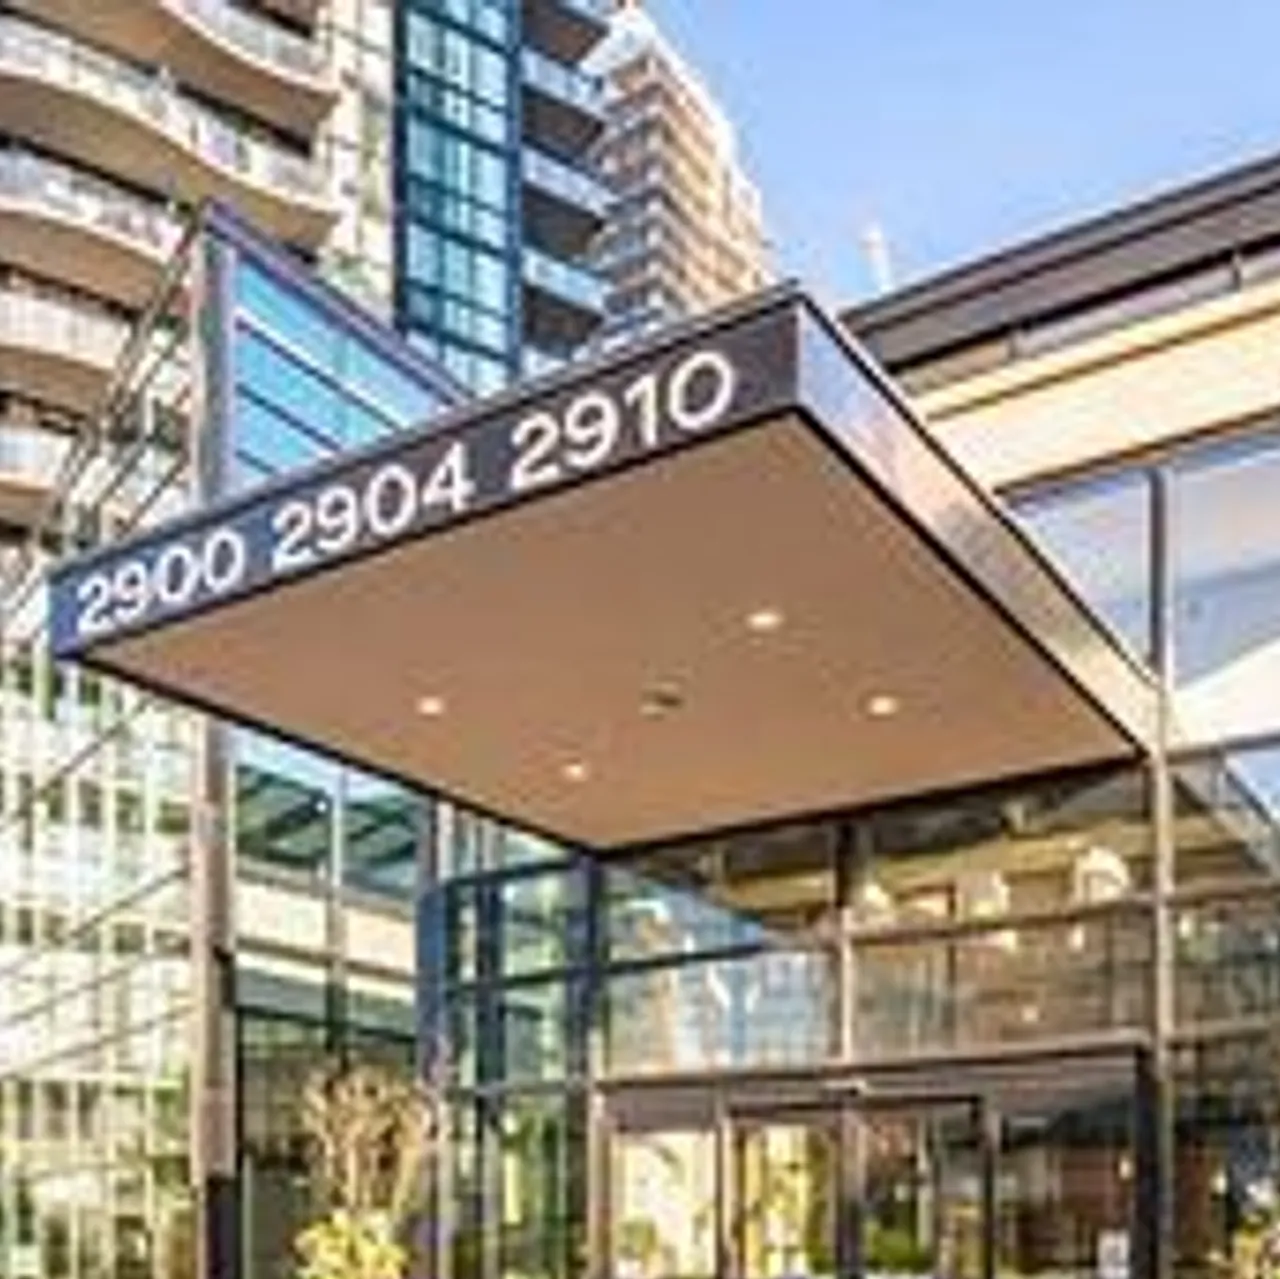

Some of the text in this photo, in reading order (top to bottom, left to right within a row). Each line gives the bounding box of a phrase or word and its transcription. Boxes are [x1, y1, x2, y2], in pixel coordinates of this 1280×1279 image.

[76, 350, 734, 634] 2900 2904 2910
